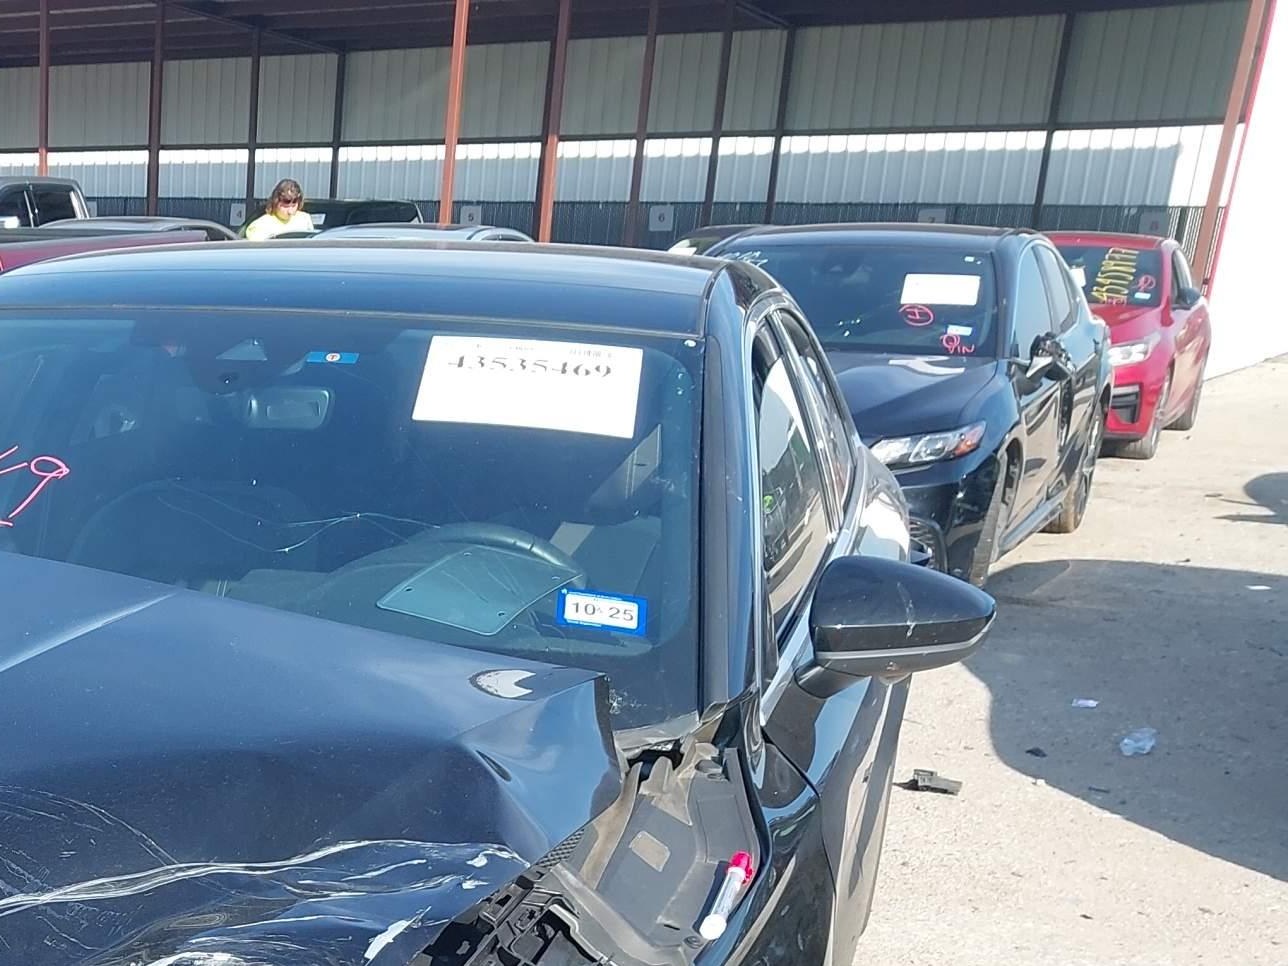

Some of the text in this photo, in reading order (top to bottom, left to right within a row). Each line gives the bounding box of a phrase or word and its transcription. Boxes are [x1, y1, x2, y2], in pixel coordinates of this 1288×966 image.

[447, 353, 613, 378] 43535469
[571, 601, 635, 622] 10 25
